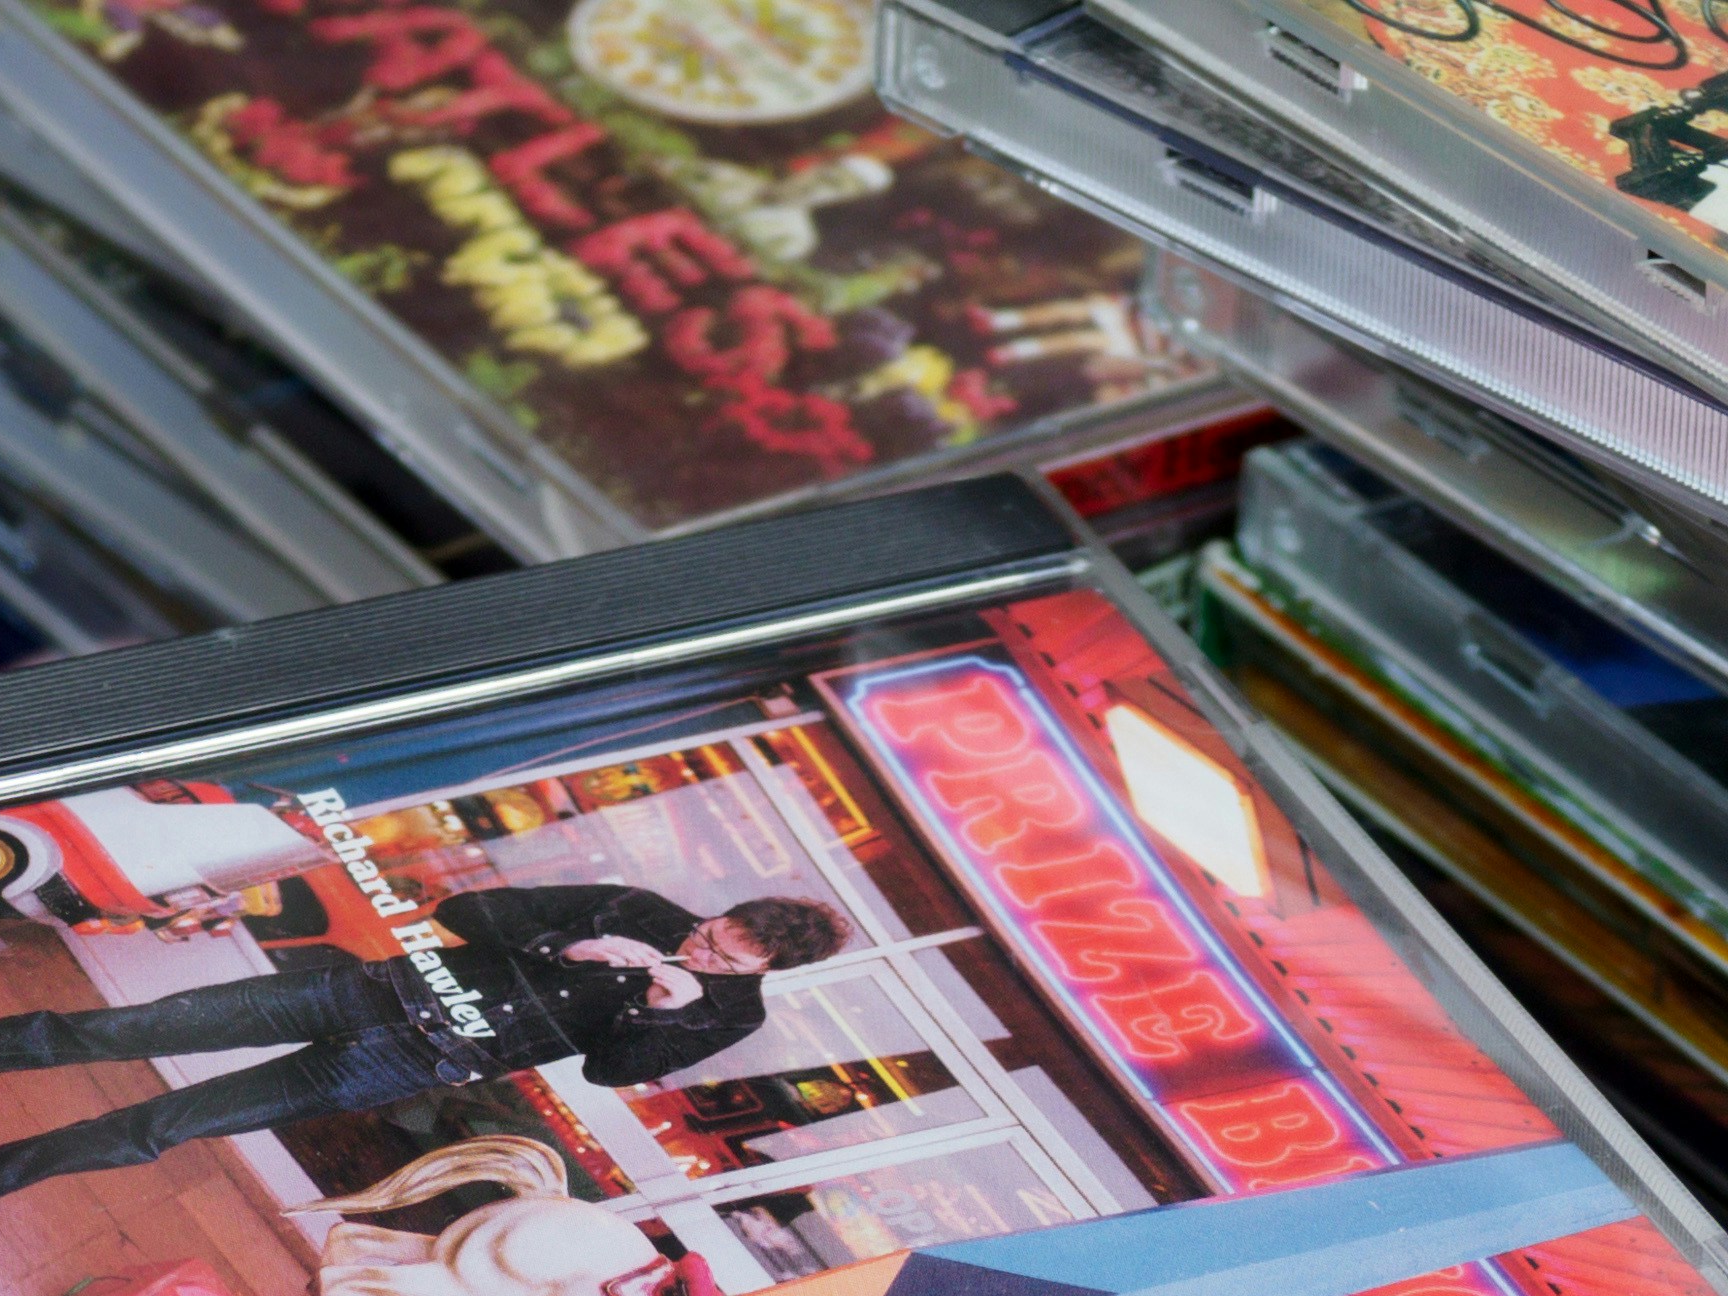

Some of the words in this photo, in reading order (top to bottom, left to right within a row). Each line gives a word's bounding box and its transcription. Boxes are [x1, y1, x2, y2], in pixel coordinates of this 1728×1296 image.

[296, 787, 419, 918] Richard
[391, 920, 497, 1038] Hawley
[873, 673, 1263, 1060] PRIZE
